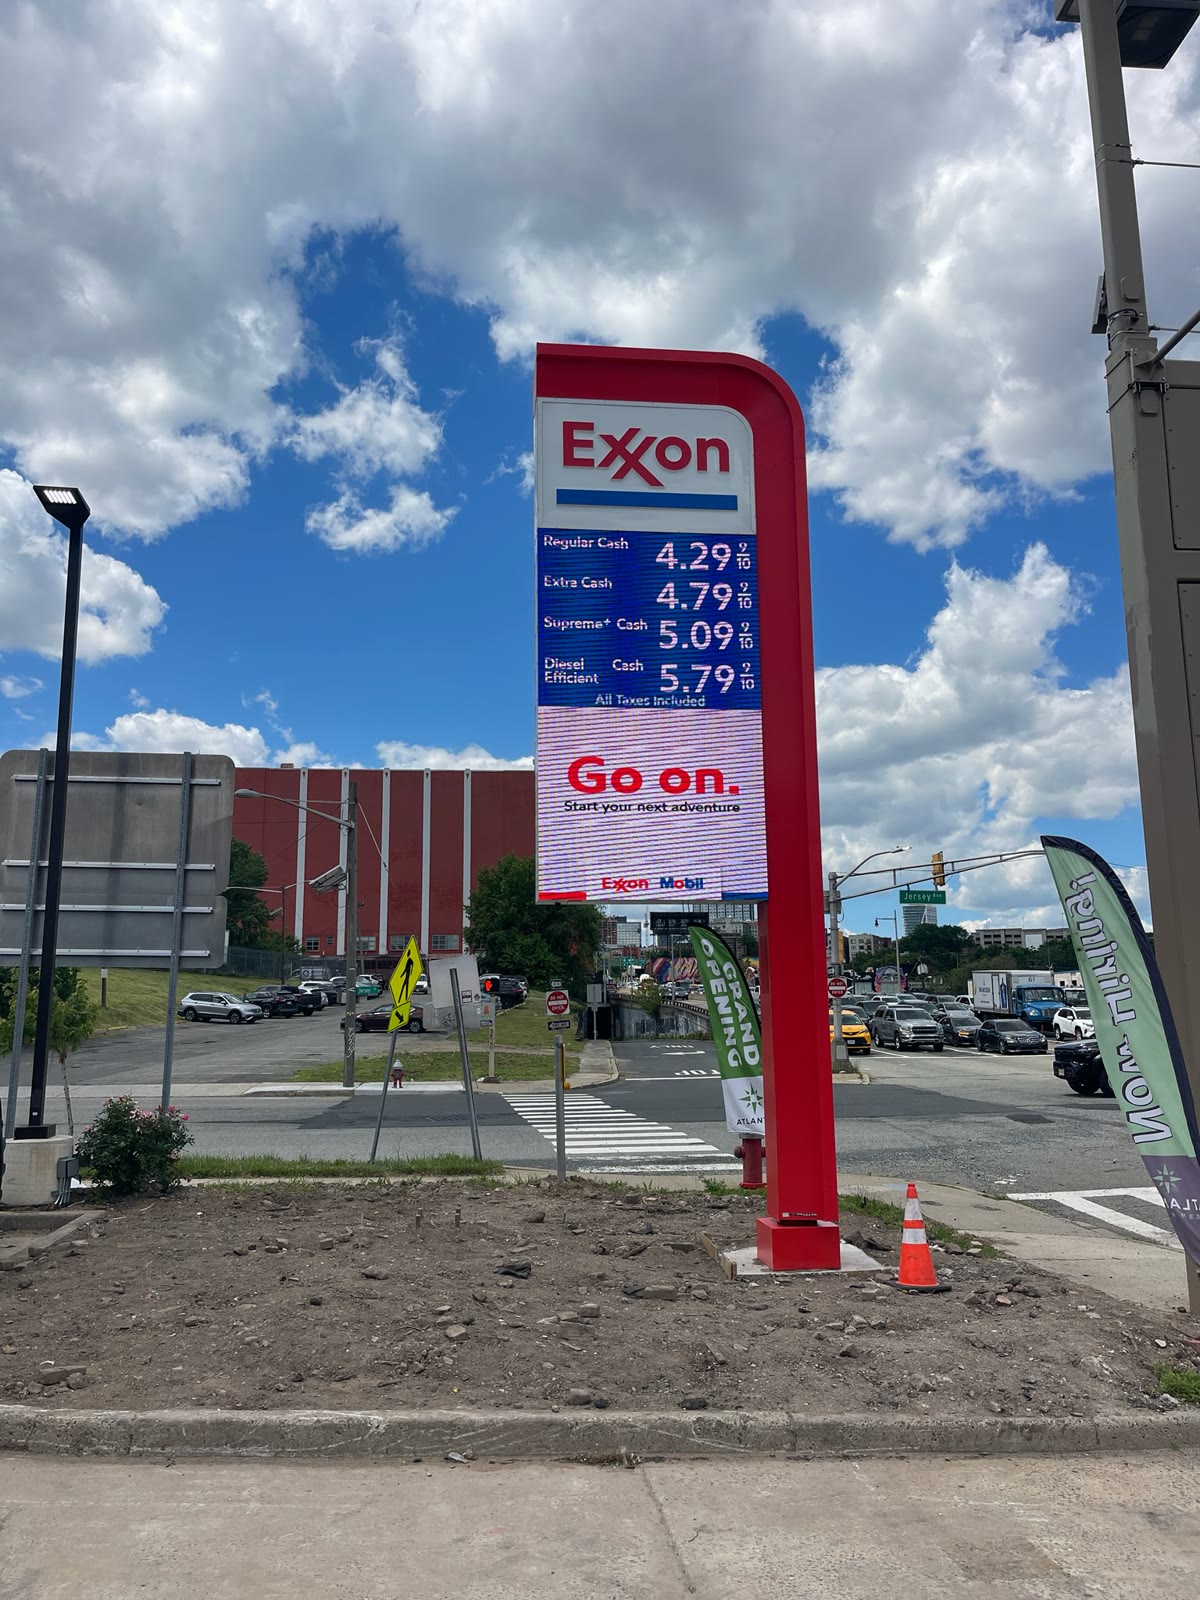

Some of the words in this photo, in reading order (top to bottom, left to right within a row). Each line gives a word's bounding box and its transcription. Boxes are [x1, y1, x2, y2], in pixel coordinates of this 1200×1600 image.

[562, 420, 730, 487] Exxon
[543, 534, 595, 550] Regular
[597, 537, 629, 549] Cash
[655, 541, 732, 571] 4.29
[543, 575, 578, 588] Extra
[581, 576, 613, 589] Cash
[656, 581, 733, 611] 4.79
[616, 618, 648, 630] Cash
[659, 619, 734, 650] 5.09
[544, 657, 584, 670] Diesel
[612, 659, 644, 671] Cash
[660, 663, 735, 694] 5.79
[544, 671, 599, 684] Efficient
[594, 693, 612, 705] All
[615, 694, 650, 706] Taxes
[653, 694, 706, 707] Included
[567, 755, 643, 794] Go
[658, 767, 740, 795] on.
[564, 800, 598, 812] Start
[602, 801, 632, 815] your
[637, 801, 668, 812] next
[671, 801, 741, 813] adventure
[601, 877, 649, 893] Exxon
[659, 876, 704, 890] Mobil
[903, 892, 931, 902] Jersey
[700, 938, 743, 1068] OPENING
[722, 961, 760, 1066] GRAND
[736, 1117, 764, 1125] ATLAN
